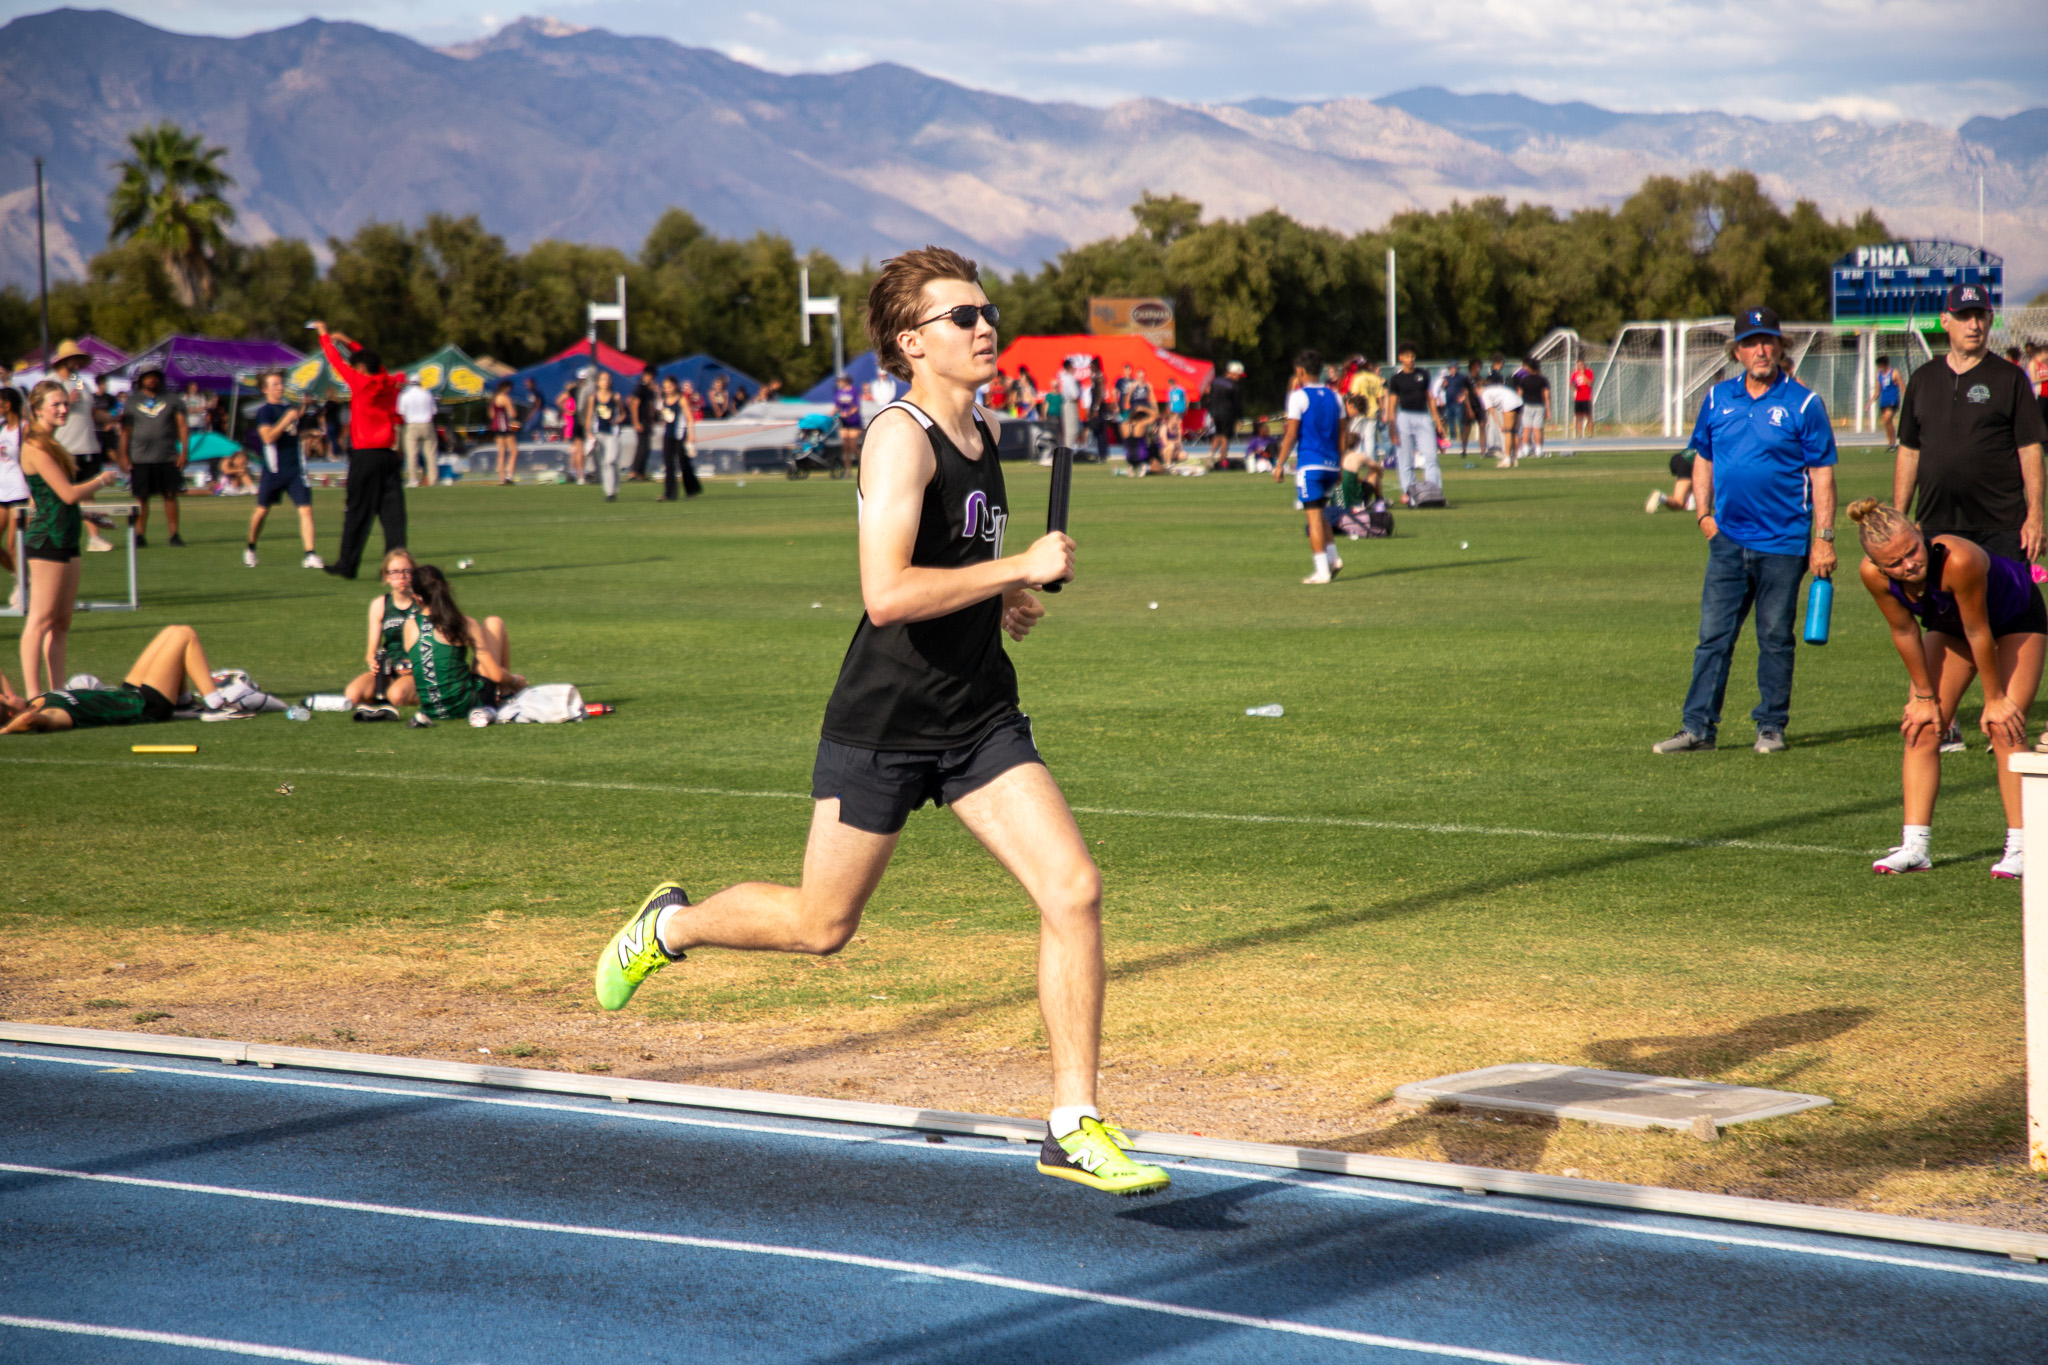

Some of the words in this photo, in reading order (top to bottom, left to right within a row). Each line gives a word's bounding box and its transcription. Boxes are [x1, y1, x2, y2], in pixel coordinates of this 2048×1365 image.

[1858, 246, 1910, 267] PIMA
[1879, 269, 1895, 279] BALL
[1907, 267, 1930, 278] STRIKE
[1066, 1147, 1108, 1173] N
